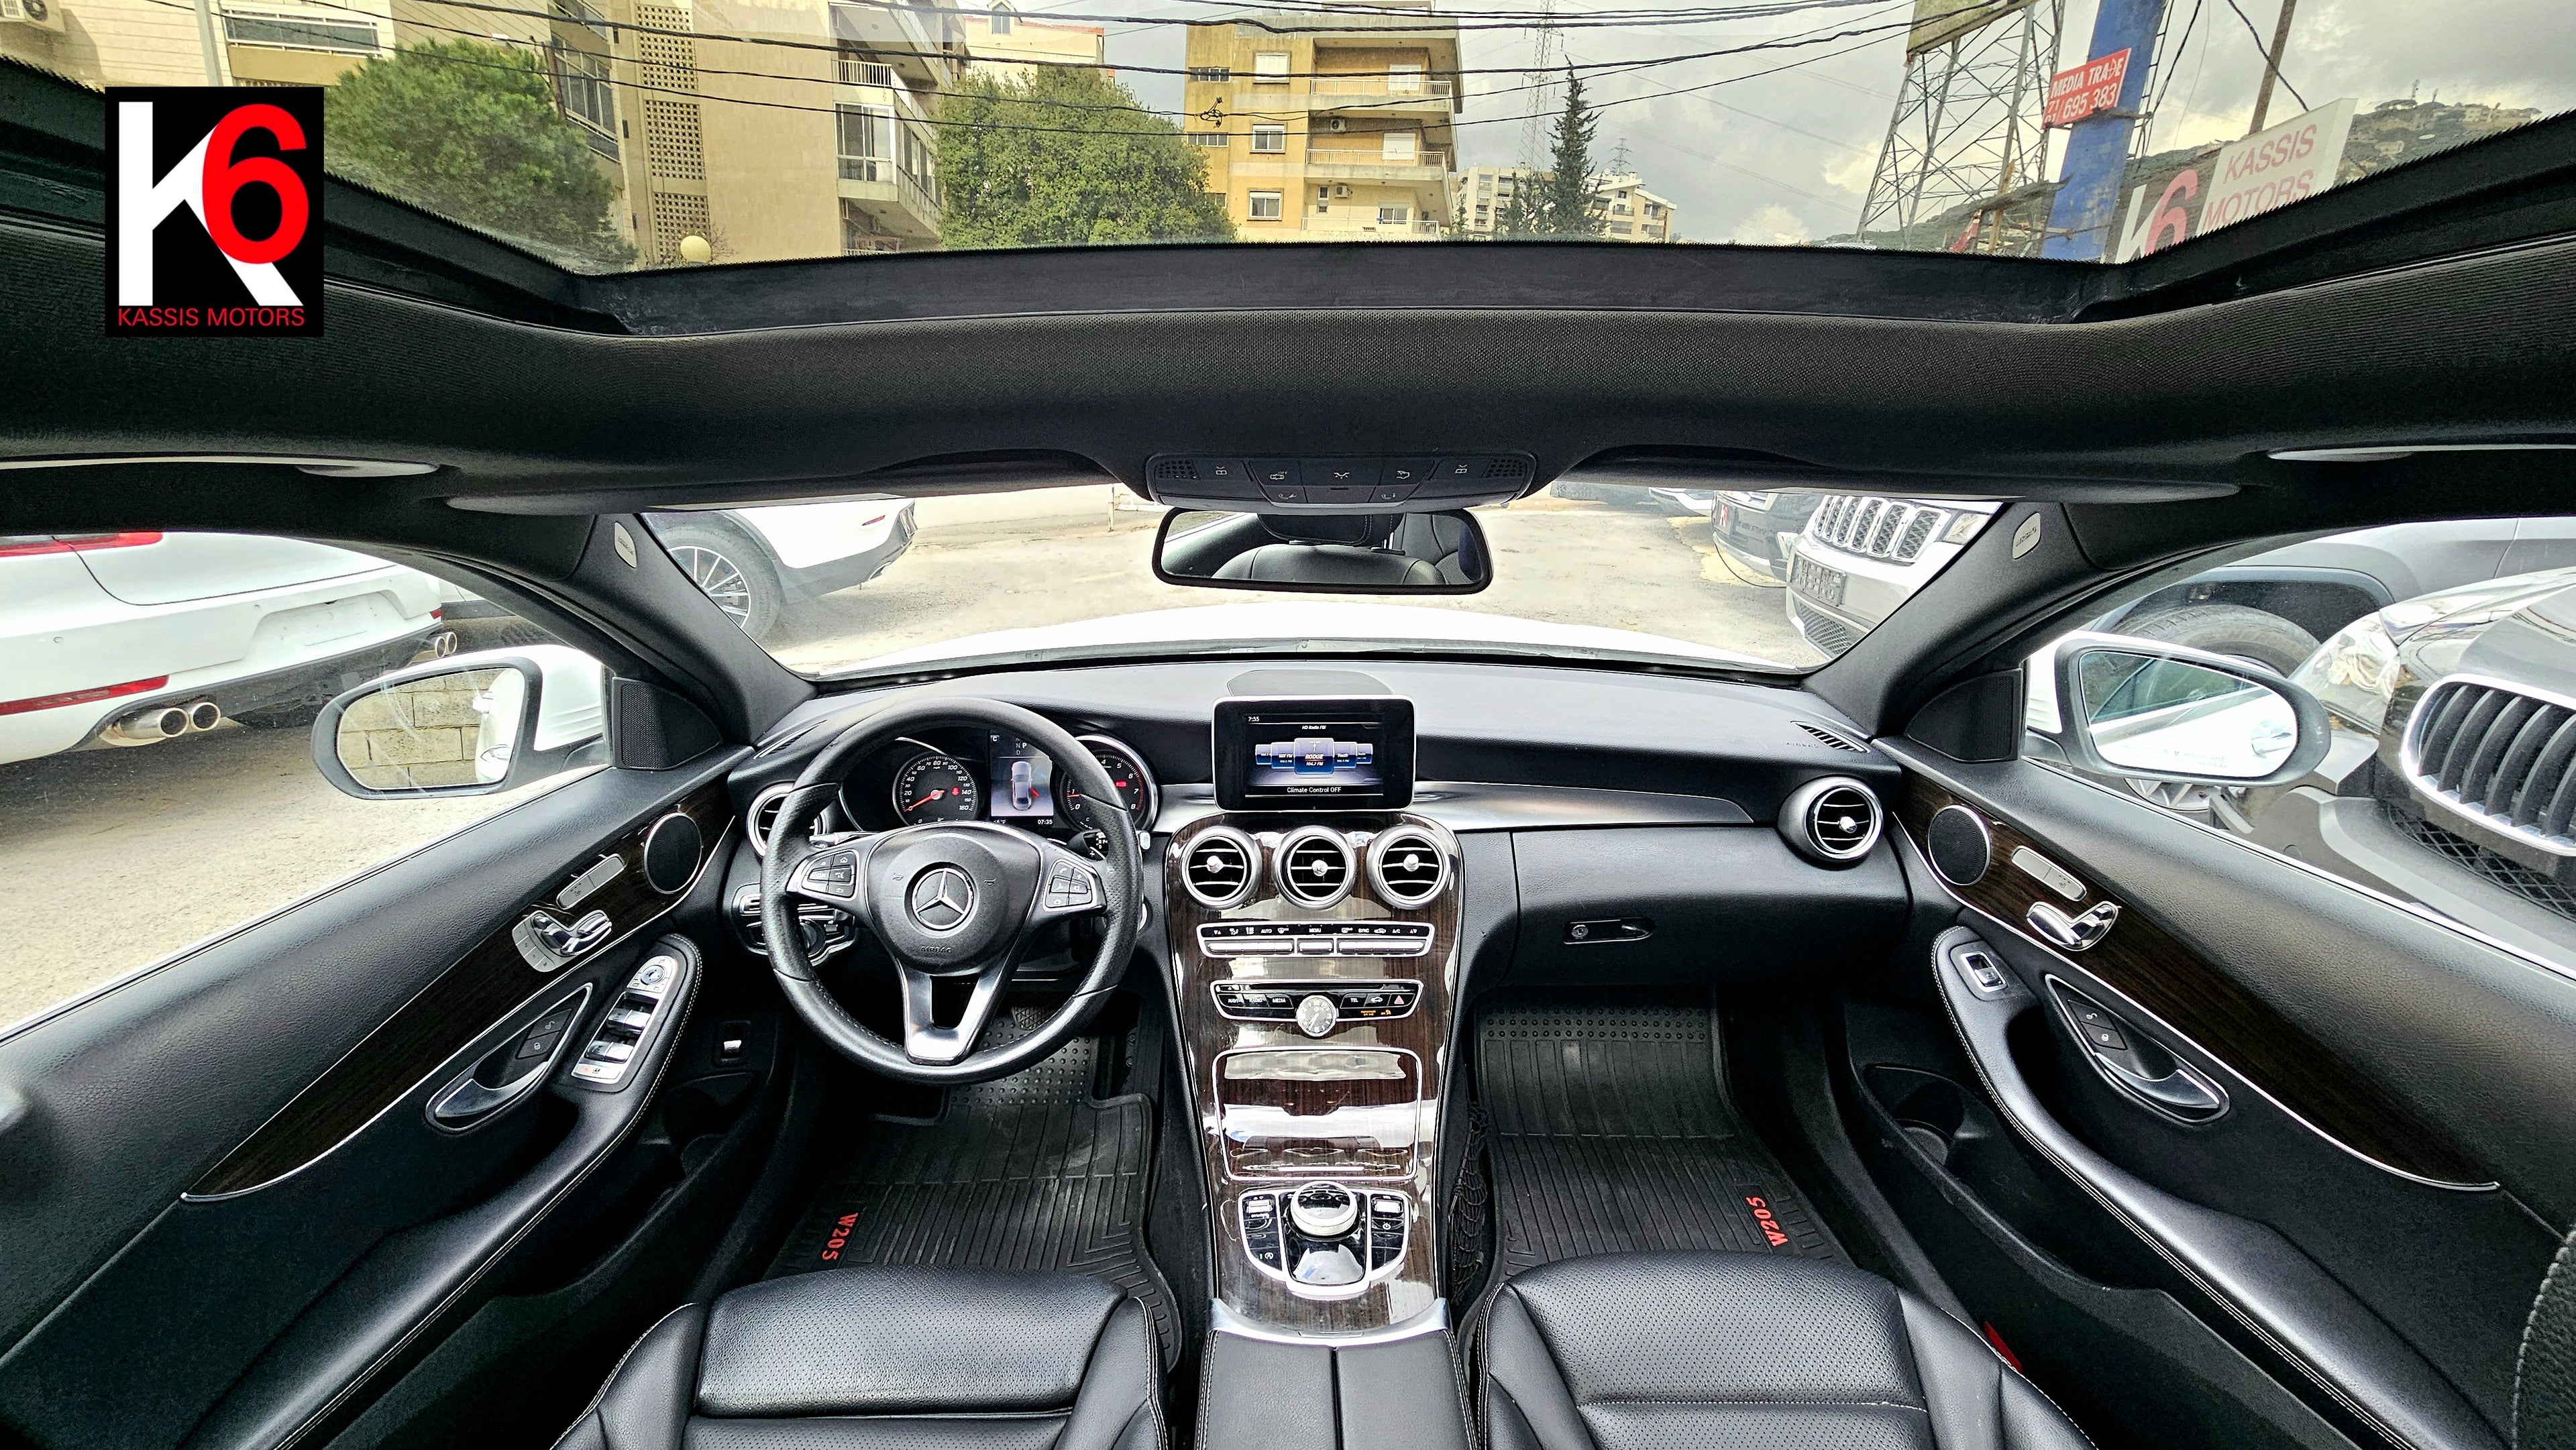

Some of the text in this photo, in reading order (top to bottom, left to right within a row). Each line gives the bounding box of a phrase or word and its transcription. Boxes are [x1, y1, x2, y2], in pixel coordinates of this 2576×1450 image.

[2050, 58, 2124, 99] MEDIA TRADE
[2090, 82, 2117, 109] 383
[2222, 124, 2317, 184] KASSIS
[2201, 169, 2314, 232] MOTORS
[822, 1213, 859, 1260] W205
[1746, 1197, 1788, 1247] W205
